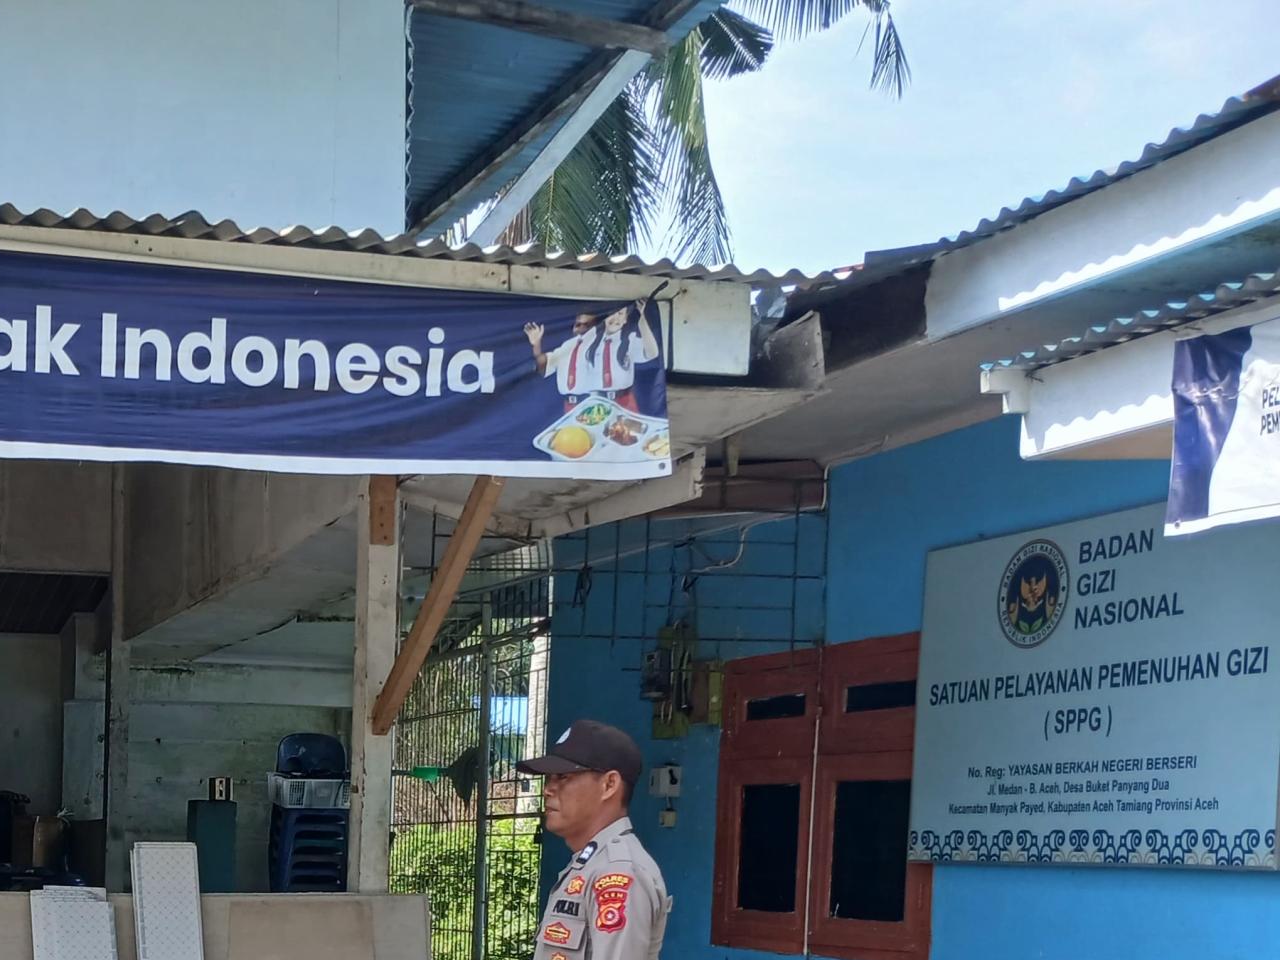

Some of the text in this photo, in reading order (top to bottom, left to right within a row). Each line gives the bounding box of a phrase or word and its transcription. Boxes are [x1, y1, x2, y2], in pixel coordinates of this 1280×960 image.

[100, 312, 496, 398] Indonesia
[1078, 528, 1154, 564] BADAN
[1076, 569, 1116, 597] GIZI
[1074, 592, 1184, 630] NASIONAL
[929, 646, 1269, 706] SATUAN PELAYANAN PEMENUHAN GIZI
[968, 755, 1197, 780] No. Reg: YAYASAN BERKAH NEGERI BERSERI
[998, 783, 1022, 795] Medan
[1039, 782, 1061, 795] Aceh,
[1063, 781, 1083, 793] Desa
[1085, 780, 1110, 793] Buket
[1112, 779, 1150, 795] Panyang
[1151, 778, 1170, 791] Dua
[948, 803, 987, 814] Kecamatan
[990, 802, 1018, 816] Manyak
[1047, 801, 1091, 815] Kabupaten
[1092, 800, 1114, 812] Aceh
[1116, 799, 1153, 814] Tamiang
[1155, 798, 1193, 811] Provinsi
[1194, 797, 1219, 810] Aceh
